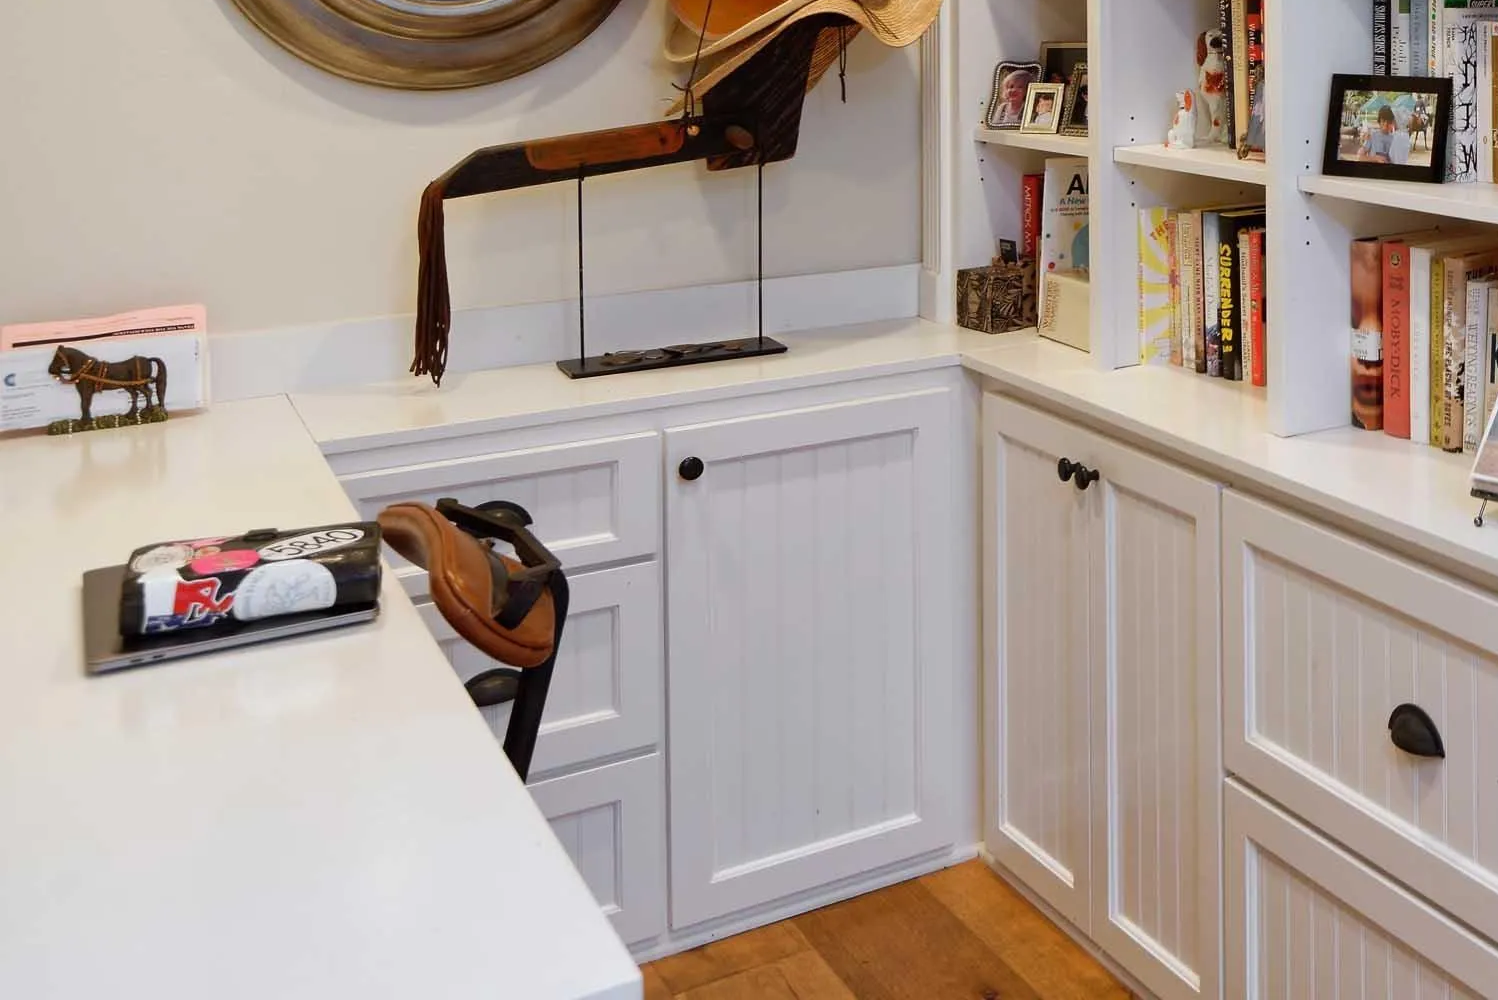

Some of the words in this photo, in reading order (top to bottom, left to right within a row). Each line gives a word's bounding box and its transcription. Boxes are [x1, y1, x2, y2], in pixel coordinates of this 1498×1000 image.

[1220, 33, 1228, 49] LEE
[1248, 23, 1256, 49] Water
[1219, 243, 1234, 341] SURRENDER
[271, 529, 358, 556] 5840
